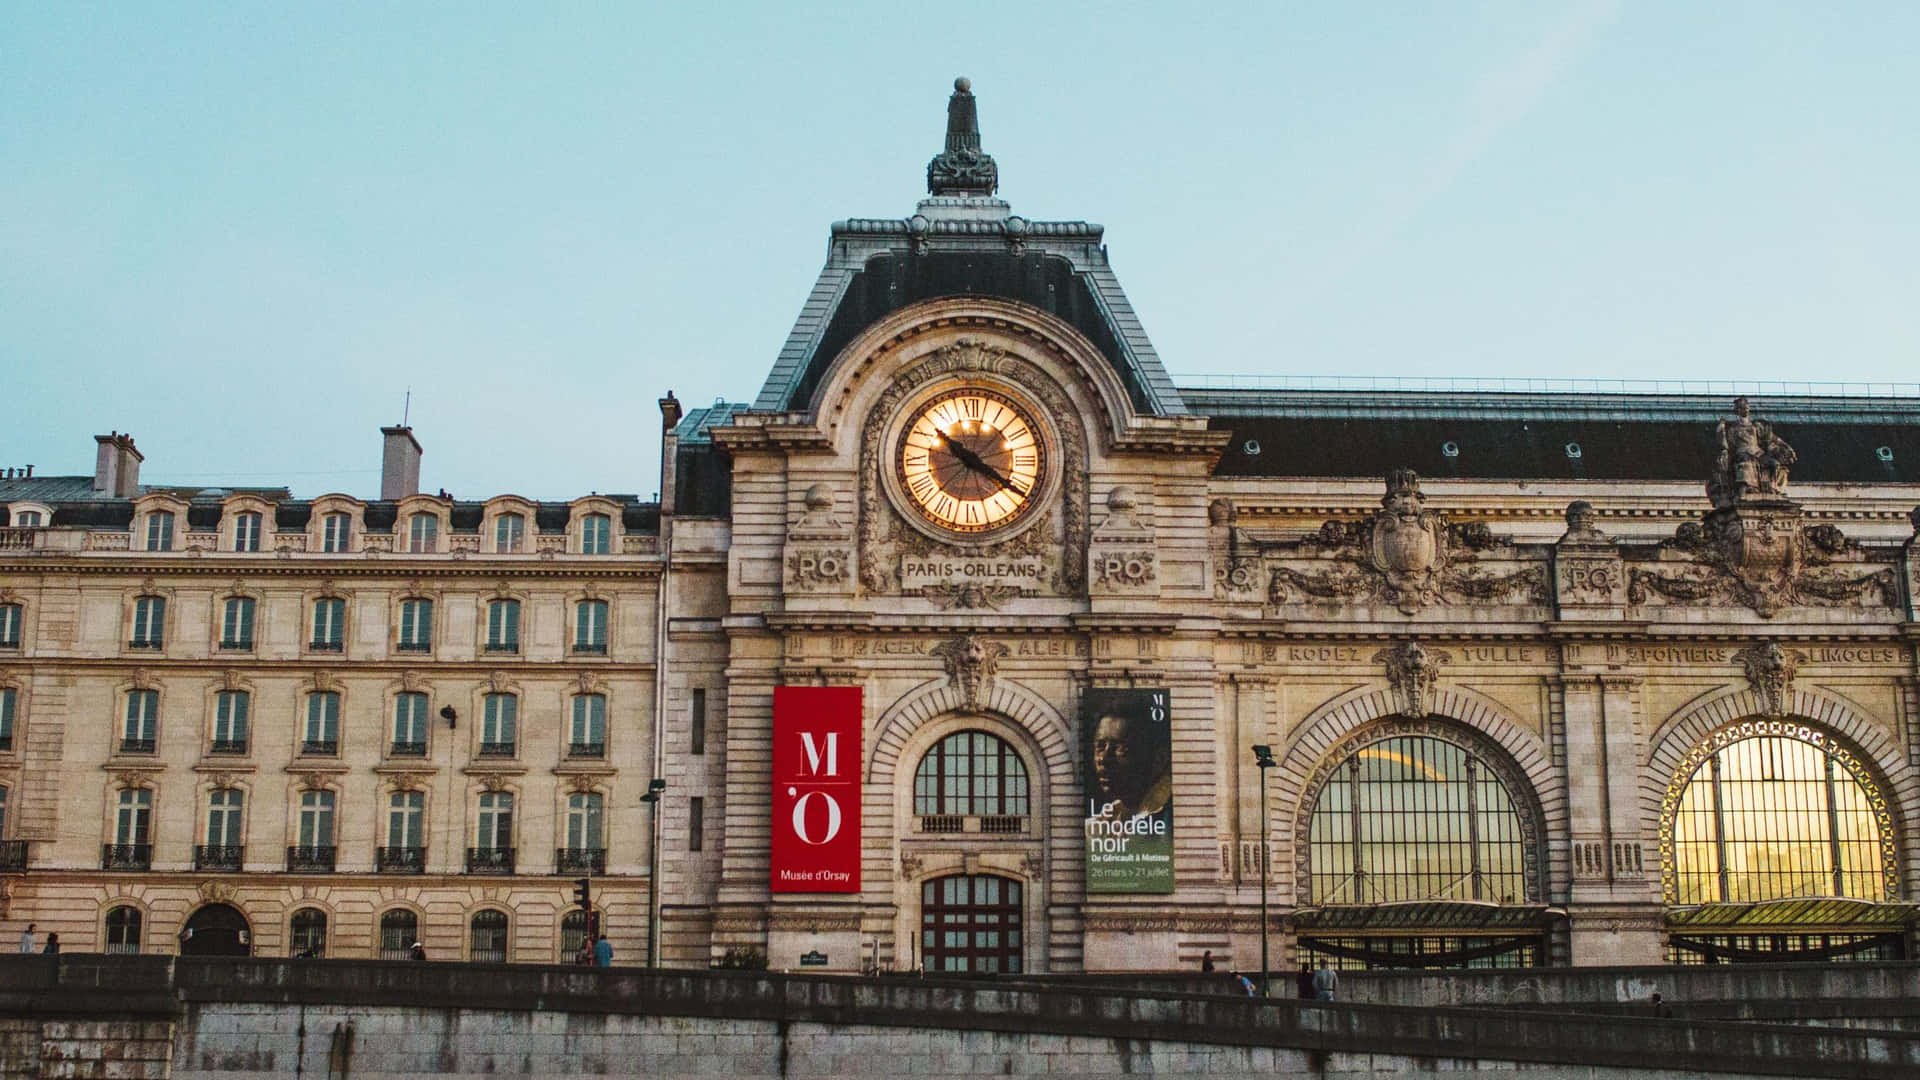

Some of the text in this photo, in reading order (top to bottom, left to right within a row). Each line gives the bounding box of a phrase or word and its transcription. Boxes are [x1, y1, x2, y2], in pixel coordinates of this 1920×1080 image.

[800, 559, 841, 577] PO
[906, 563, 1036, 577] PARIS-ORLEANS
[1105, 560, 1144, 578] PO
[1289, 647, 1361, 661] RODEZ
[1462, 647, 1532, 661] TULLE
[795, 731, 843, 776] M
[1090, 798, 1113, 817] Le
[1091, 838, 1129, 853] noir
[780, 869, 813, 881] Musée
